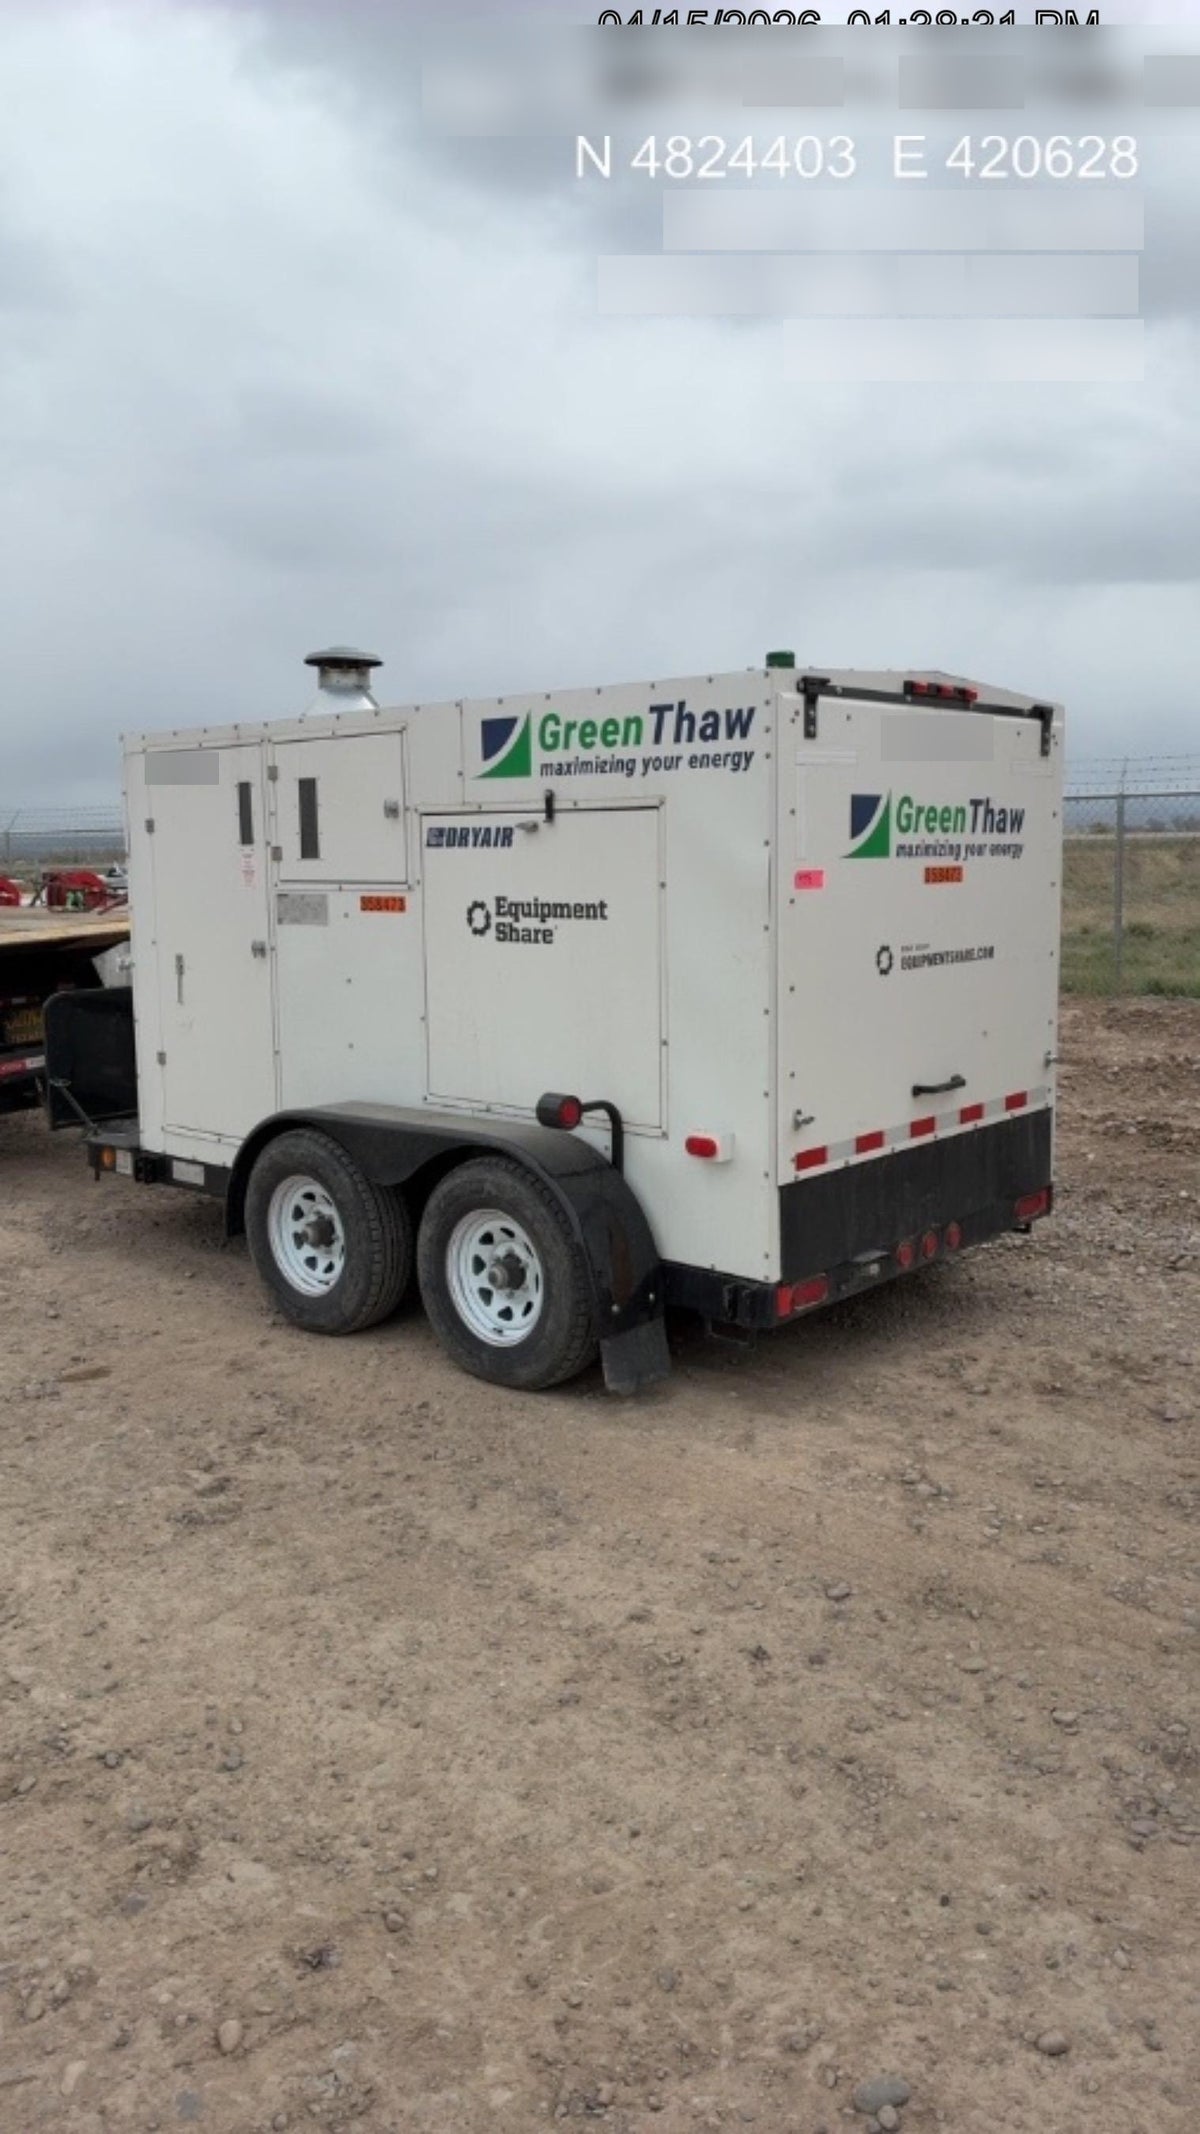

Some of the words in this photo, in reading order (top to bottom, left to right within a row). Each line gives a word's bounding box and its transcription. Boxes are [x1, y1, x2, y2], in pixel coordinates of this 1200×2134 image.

[540, 754, 637, 778] maximizing
[641, 753, 682, 778] your
[687, 750, 755, 772] energy
[445, 827, 514, 848] DRYAIR
[963, 843, 988, 861] your
[495, 896, 608, 923] Equipment
[495, 922, 554, 944] Share
